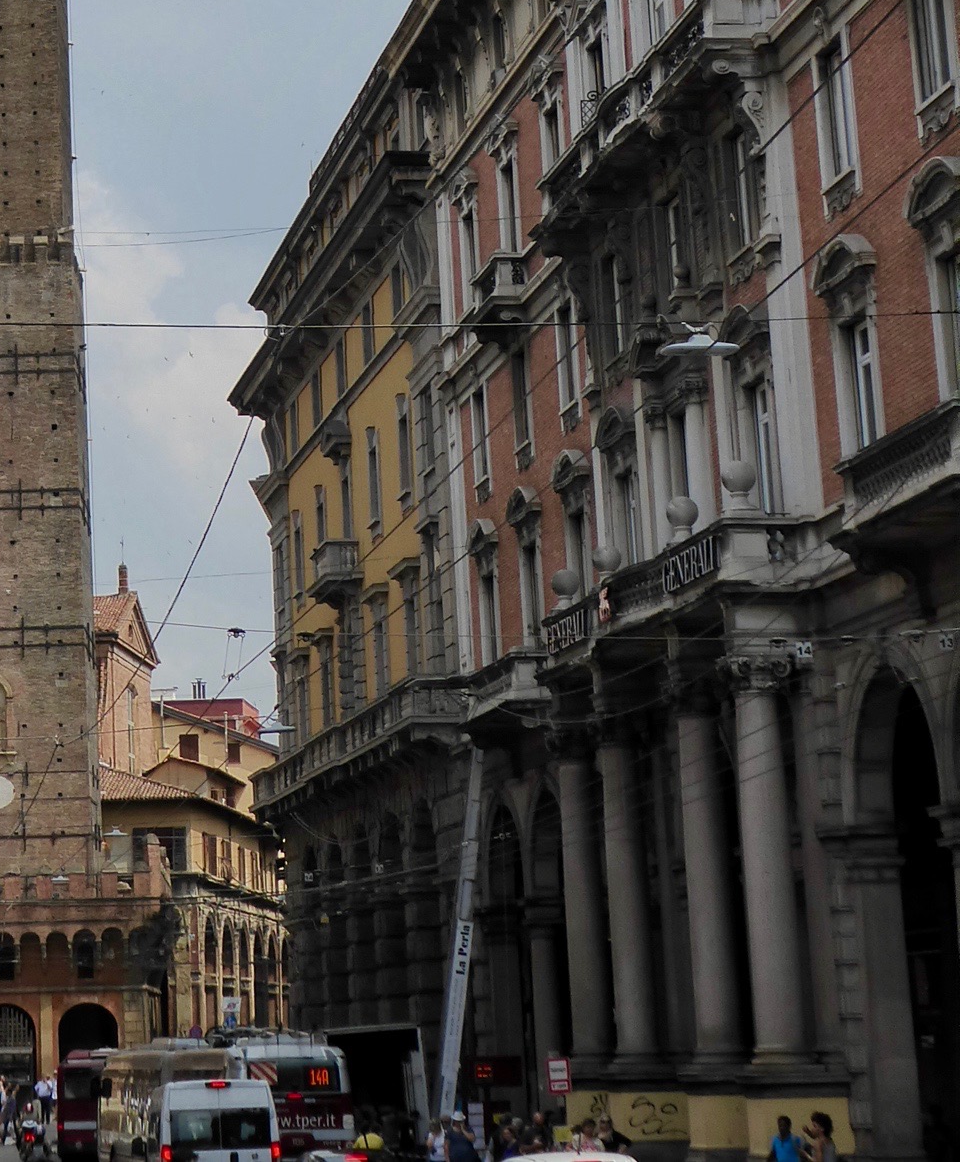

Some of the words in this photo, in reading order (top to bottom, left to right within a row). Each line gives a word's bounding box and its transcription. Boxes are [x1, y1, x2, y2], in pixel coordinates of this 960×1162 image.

[661, 536, 715, 594] GENERALI
[546, 608, 586, 655] GENERALI
[796, 645, 812, 656] 14
[457, 924, 471, 957] Perla
[456, 960, 467, 976] La
[309, 1068, 330, 1086] 14A
[277, 1113, 337, 1130] w.tper.it
